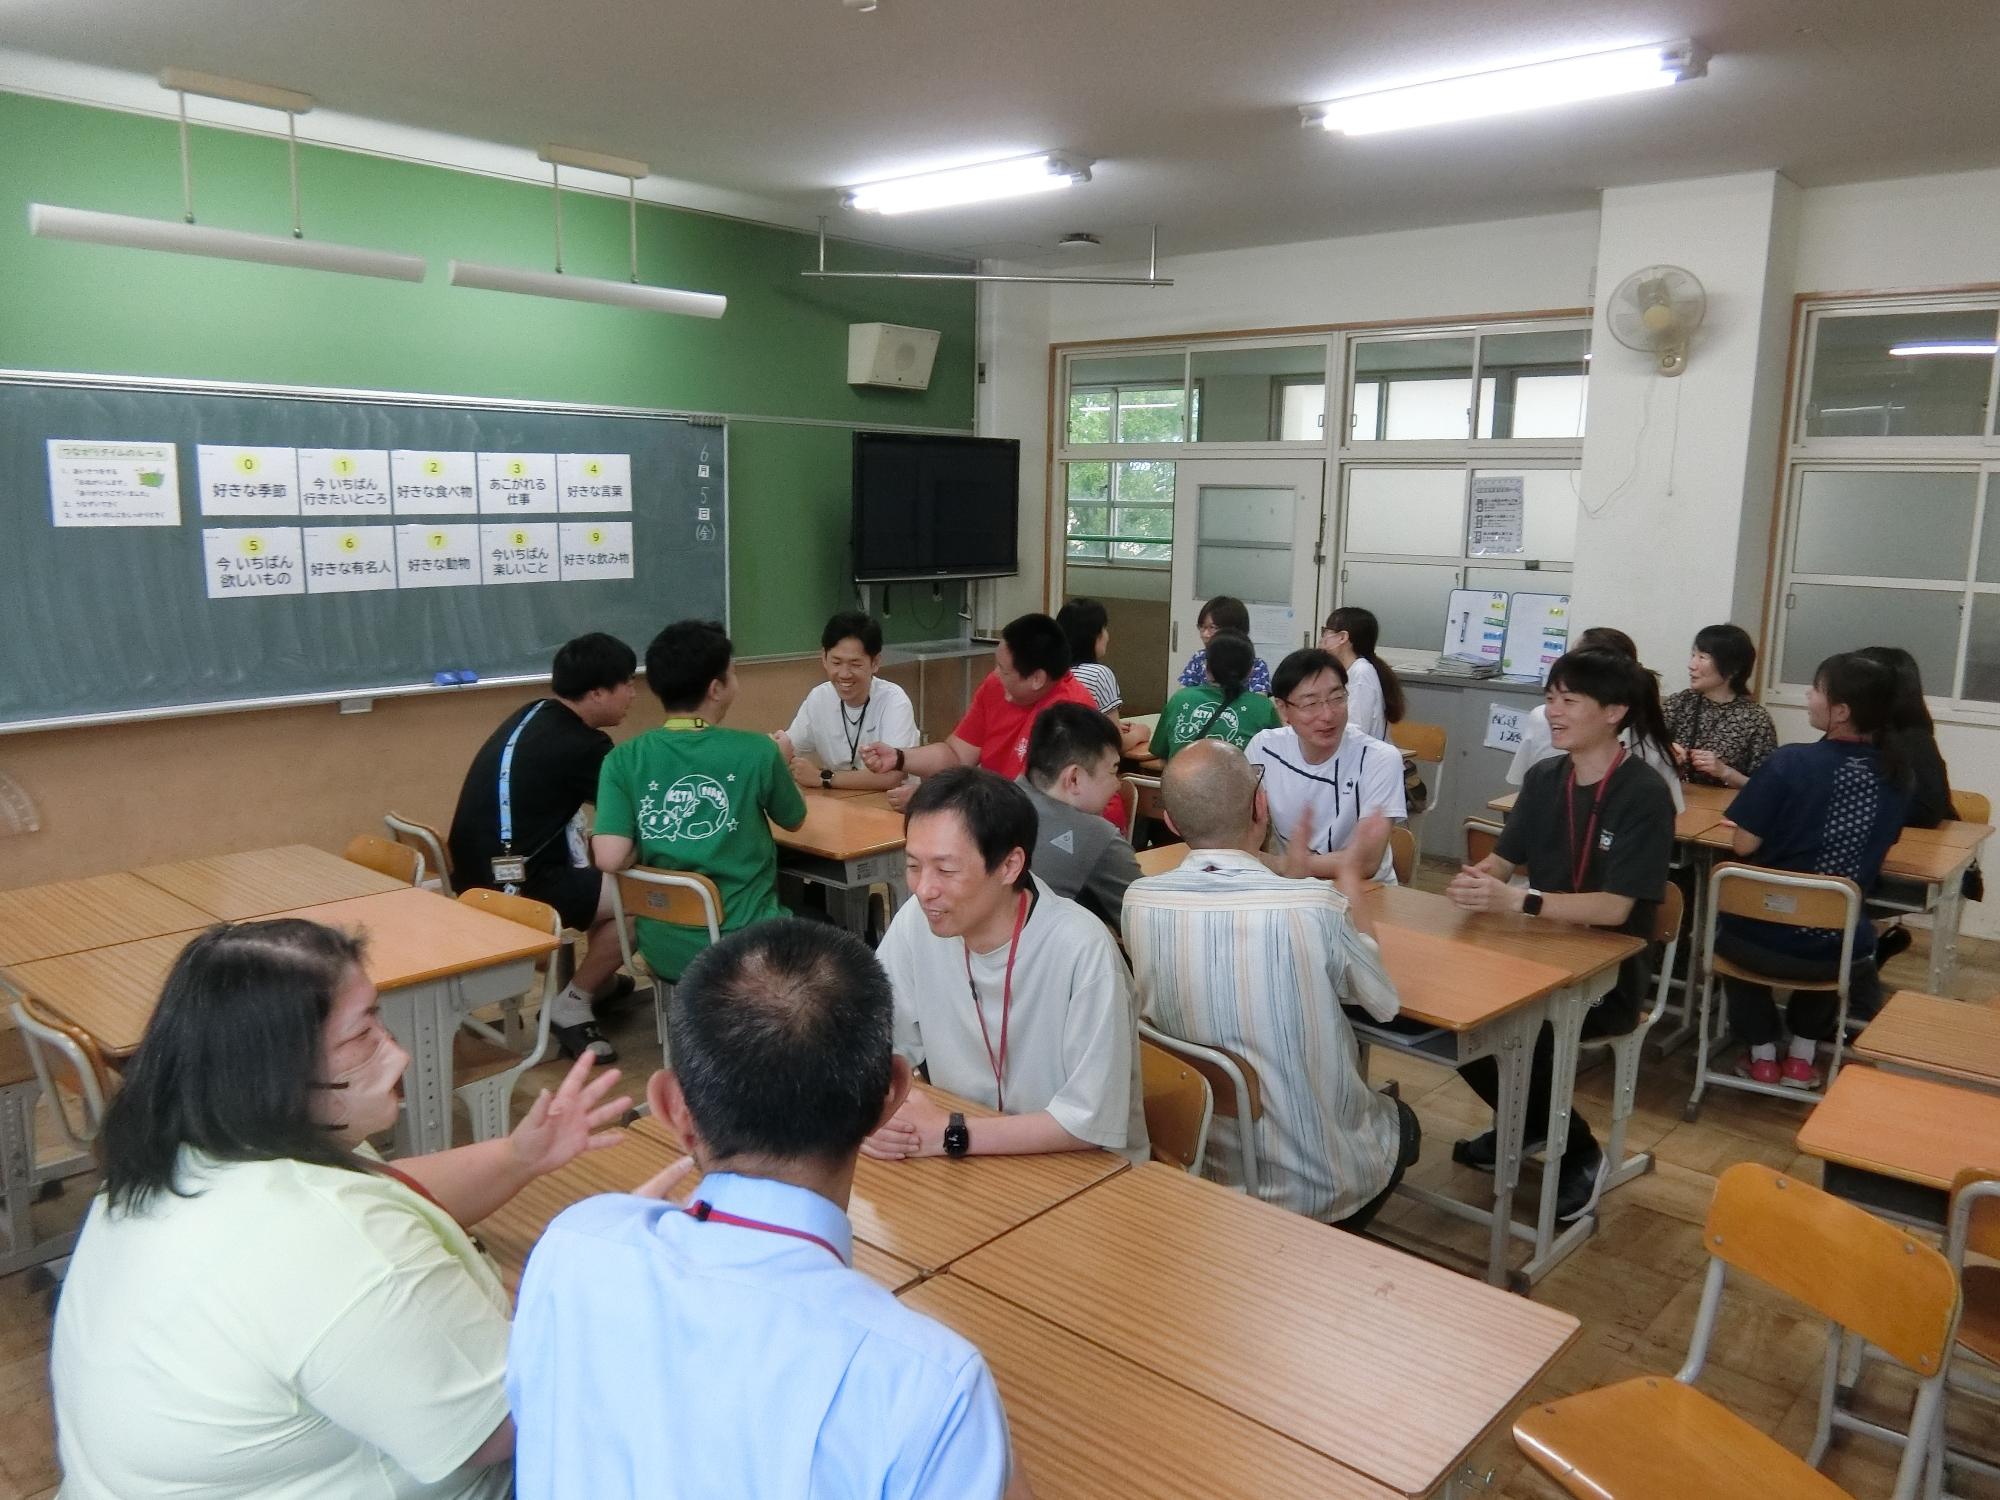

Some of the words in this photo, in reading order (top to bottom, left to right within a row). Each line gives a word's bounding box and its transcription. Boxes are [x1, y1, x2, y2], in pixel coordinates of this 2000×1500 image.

[244, 458, 253, 470] 0
[341, 460, 347, 471] 1
[430, 462, 438, 473] 2
[513, 463, 521, 474] 3
[590, 464, 598, 473] 4
[212, 483, 287, 498] 好きな季節
[312, 477, 326, 491] 今
[330, 478, 377, 491] いちばん
[490, 478, 546, 491] あこがれる
[396, 485, 473, 499] 好きな食べ物
[567, 485, 623, 498] 好きな言葉
[303, 492, 387, 506] 行きたいところ
[507, 493, 531, 506] 仕事
[345, 538, 354, 549] 6
[434, 535, 442, 545] 7
[515, 533, 524, 544] 8
[592, 532, 600, 542] 9
[249, 540, 258, 551] 5
[491, 547, 549, 562] 今いちばん
[564, 552, 630, 566] 好きな飲み物
[215, 556, 231, 572] 今
[236, 555, 292, 571] いちばん
[310, 560, 391, 577] 好きな有名人
[407, 557, 471, 572] 好きな動物
[493, 562, 547, 576] 楽しいこと
[220, 572, 291, 589] 欲しいもの
